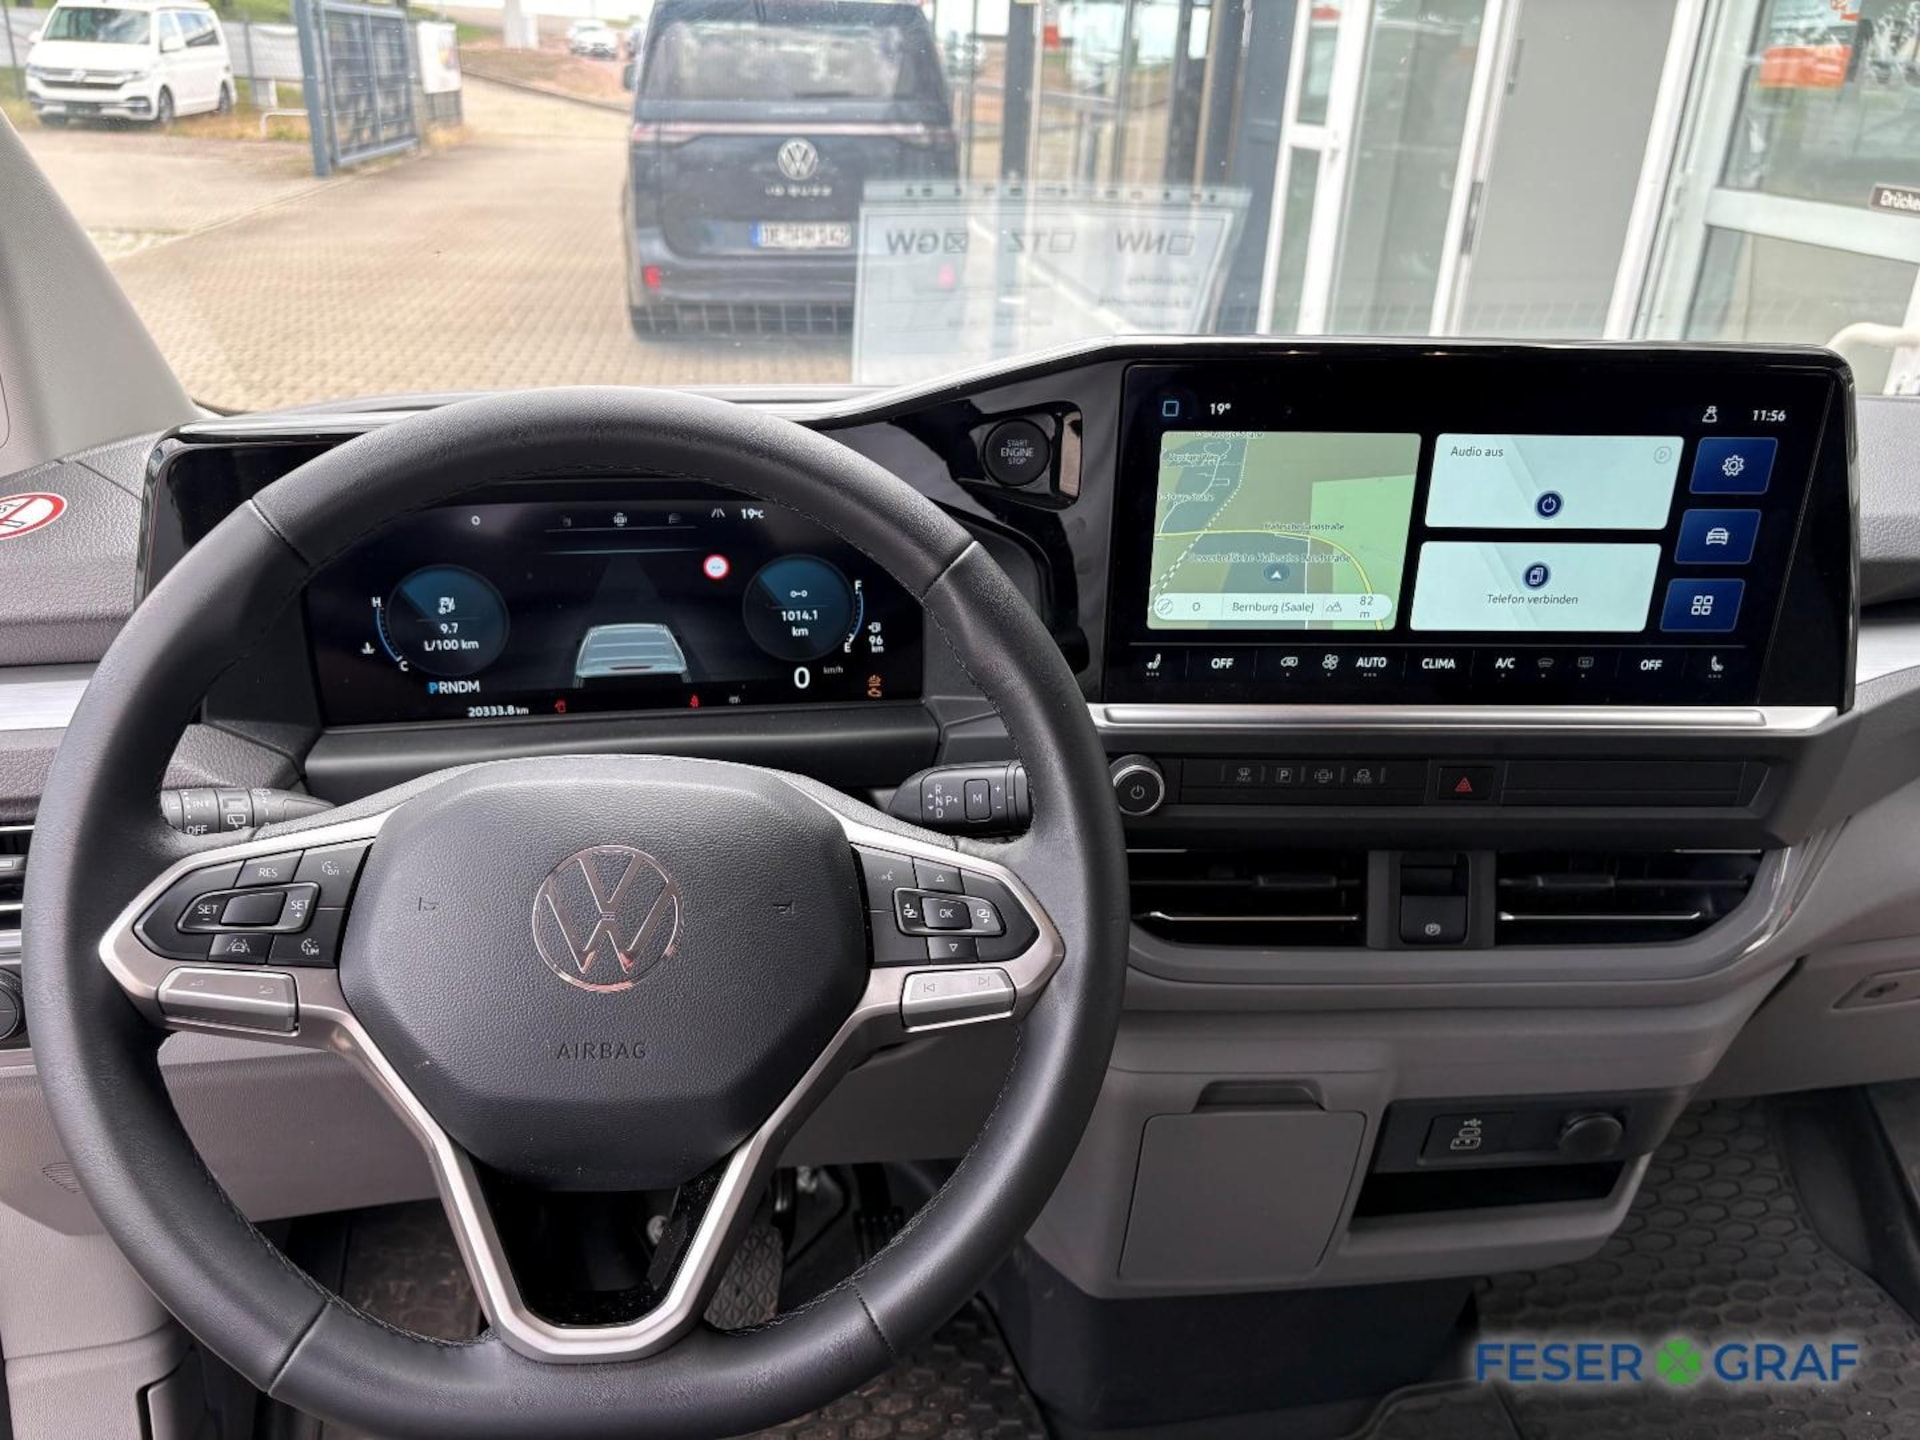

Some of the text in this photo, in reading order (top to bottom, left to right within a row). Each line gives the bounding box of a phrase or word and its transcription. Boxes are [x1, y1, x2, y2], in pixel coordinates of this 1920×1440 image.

[1752, 410, 1786, 422] 11:56
[1000, 447, 1034, 457] ENGINE
[1451, 446, 1504, 457] Audio aus
[855, 580, 862, 592] F
[372, 597, 381, 607] H
[1359, 597, 1374, 606] 82
[1487, 594, 1578, 605] Telefon verbinden
[1232, 602, 1278, 614] Bernburg
[1281, 602, 1314, 614] (Saale)
[781, 610, 818, 621] 1014.1
[440, 623, 459, 634] 9.7
[792, 626, 809, 637] km
[424, 638, 479, 651] L/100 km
[869, 635, 883, 645] 96
[400, 661, 409, 671] C
[1211, 658, 1234, 669] OFF
[1356, 657, 1387, 669] AUTO
[1422, 658, 1456, 669] CLIMA
[1495, 657, 1515, 669] A/C
[1640, 659, 1662, 671] OFF
[823, 666, 843, 675] km/h
[794, 667, 810, 689] 0
[428, 682, 480, 694] PRNDM
[935, 785, 942, 794] R
[973, 794, 982, 803] M
[937, 809, 944, 818] D
[187, 825, 208, 835] OFF
[259, 868, 277, 878] RES
[198, 905, 219, 914] SET
[940, 908, 954, 918] OK
[557, 1042, 647, 1060] AIRBAG
